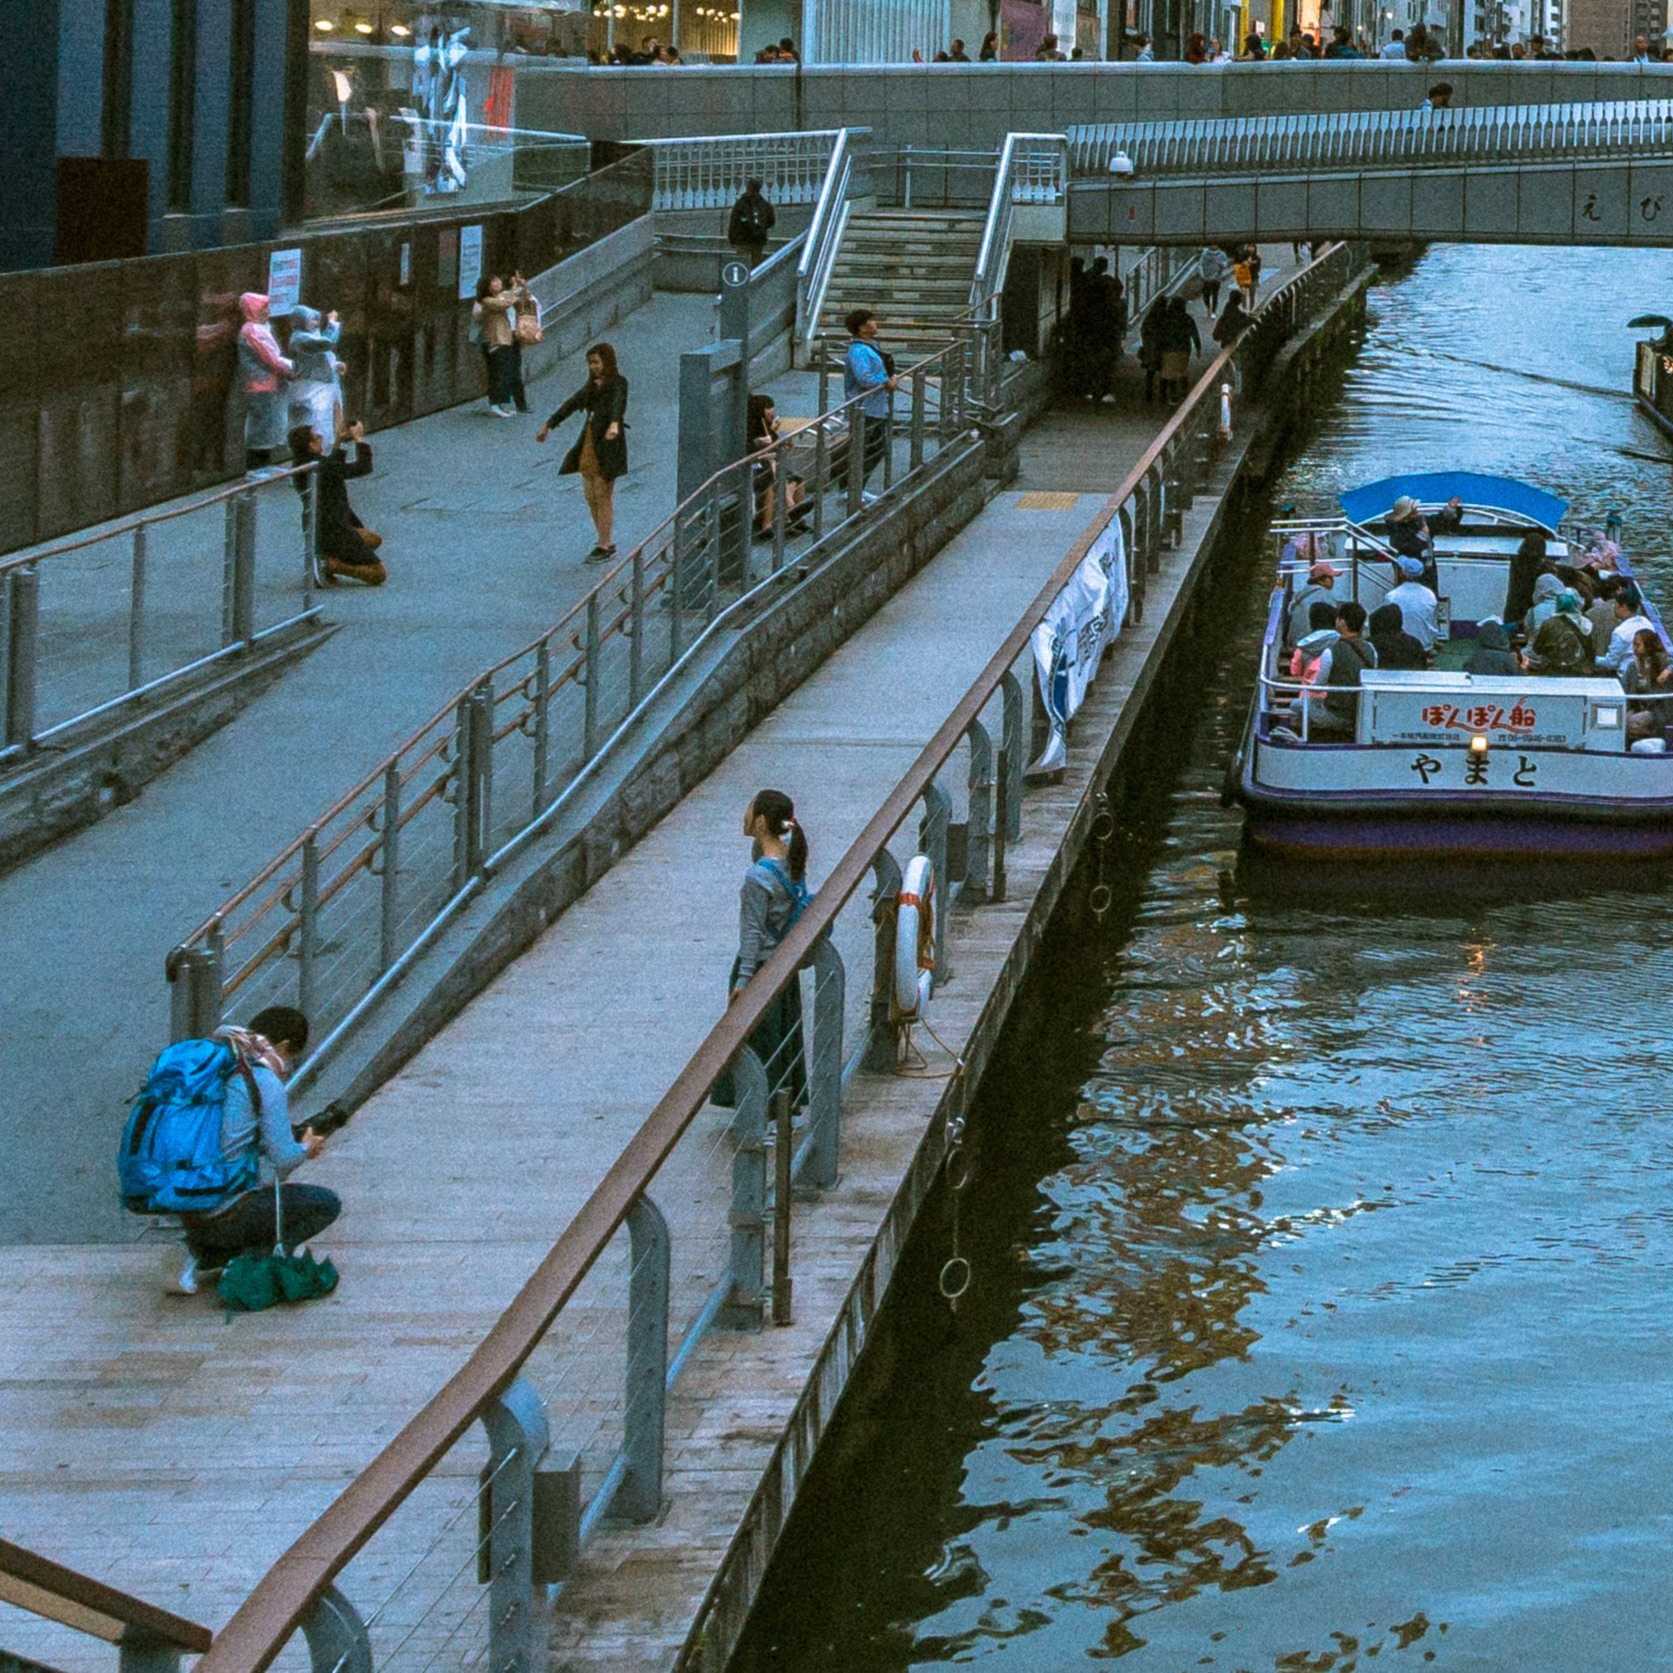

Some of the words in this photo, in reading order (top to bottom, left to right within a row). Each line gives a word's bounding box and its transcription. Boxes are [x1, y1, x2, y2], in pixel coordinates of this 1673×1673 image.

[1421, 694, 1537, 734] ぽんぽん船
[1411, 753, 1538, 787] やまと
